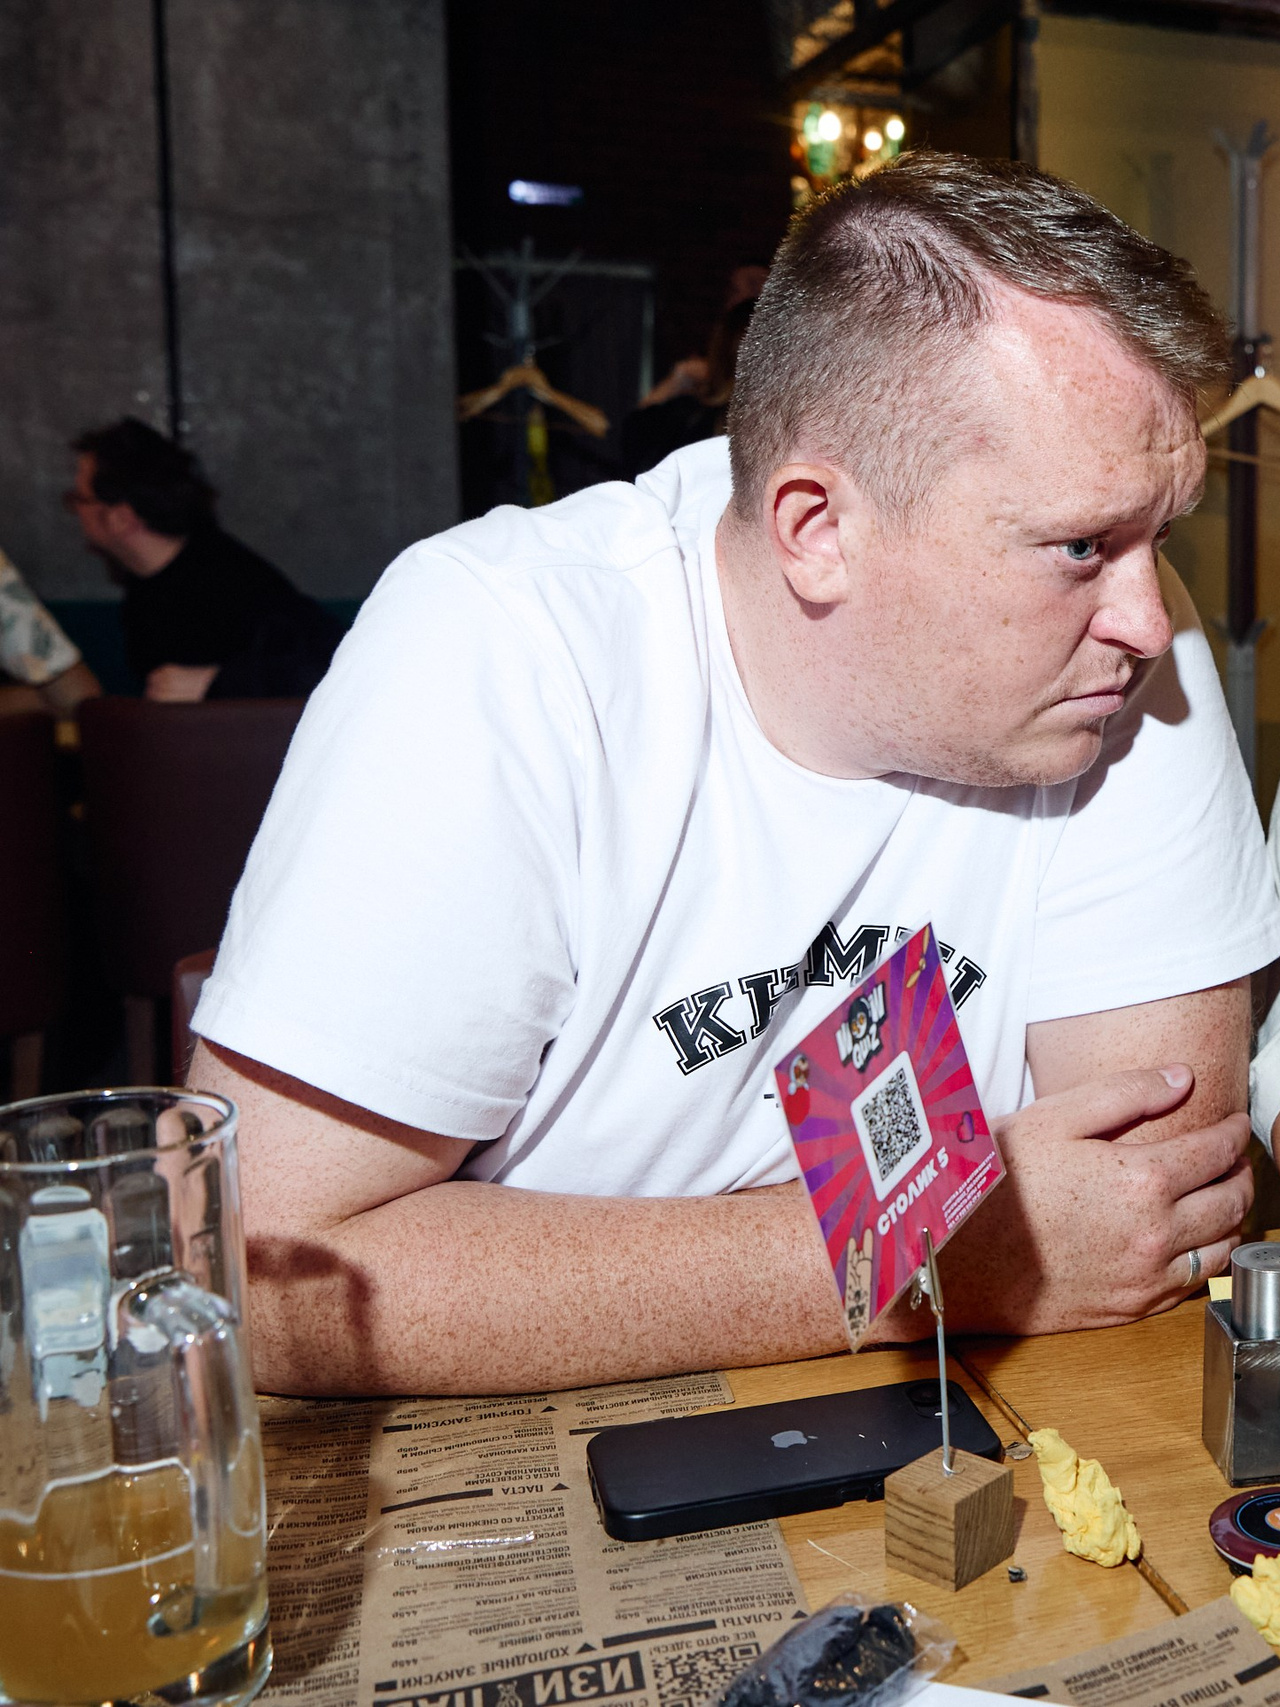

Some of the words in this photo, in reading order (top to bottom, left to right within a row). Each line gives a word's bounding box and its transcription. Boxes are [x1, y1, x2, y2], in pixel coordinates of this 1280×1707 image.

[852, 1022, 882, 1071] QUIZ
[878, 1166, 939, 1235] СТОЛИК
[936, 1147, 949, 1168] 5
[476, 1408, 531, 1420] ГОРЯЧИЕ
[414, 1417, 472, 1429] ЗАКУСКИ
[514, 1430, 554, 1439] РАВИОЛИ
[444, 1436, 500, 1451] СЛИВОЧНЫМ
[409, 1447, 442, 1456] СЫРОМ
[478, 1447, 528, 1458] КАРБОНАРА
[504, 1466, 552, 1475] ТОМАТНОМ
[465, 1475, 523, 1485] КРЕВЕТКАМИ
[501, 1485, 544, 1495] ПАСТА
[515, 1512, 565, 1522] БРУСКЕТТА
[525, 1507, 556, 1515] ИКРОЙ
[407, 1524, 445, 1534] КРАБОМ
[448, 1518, 499, 1529] СНЕЖНЫМ
[741, 1522, 770, 1531] САЛАТ
[675, 1529, 731, 1542] РОСТБИФОМ
[498, 1545, 570, 1559] СОБСТВЕННОГО
[724, 1543, 778, 1557] ГРЕЧЕСКИЙ
[536, 1551, 571, 1562] ЧИПСЫ
[458, 1557, 534, 1570] КАРТОФЕЛЬНЫЕ
[755, 1561, 784, 1569] САЛАТ
[509, 1575, 531, 1583] УШИ
[533, 1569, 574, 1578] СВИНЫЕ
[685, 1566, 752, 1581] МЮНХЕНСКИЙ
[454, 1578, 507, 1588] КОПЧЕНЫЕ
[537, 1585, 577, 1597] СЕЛЬДЬ
[475, 1594, 519, 1606] ГРЕНКАХ
[733, 1592, 783, 1603] ПАСТРАМИ
[767, 1597, 796, 1606] САЛАТ
[669, 1599, 716, 1612] ИНДЕЙКИ
[544, 1610, 580, 1621] ТАРТАР
[646, 1609, 697, 1623] СУЛУГУНИ
[722, 1611, 782, 1626] САЛАТЫ
[468, 1619, 526, 1635] ГОВЯДИНЫ
[545, 1627, 583, 1639] КЕШЬЮ
[498, 1633, 543, 1648] ПИВНЫЕ
[696, 1634, 730, 1647] ФОТО
[732, 1630, 756, 1640] ВСЕ
[648, 1640, 693, 1656] ЗДЕСЬ!
[480, 1646, 570, 1673] ХОЛОДНЫЕ
[400, 1665, 476, 1688] ЗАКУСКИ
[532, 1656, 634, 1705] ИЗИ
[1180, 1679, 1234, 1706] ПИЦЦА
